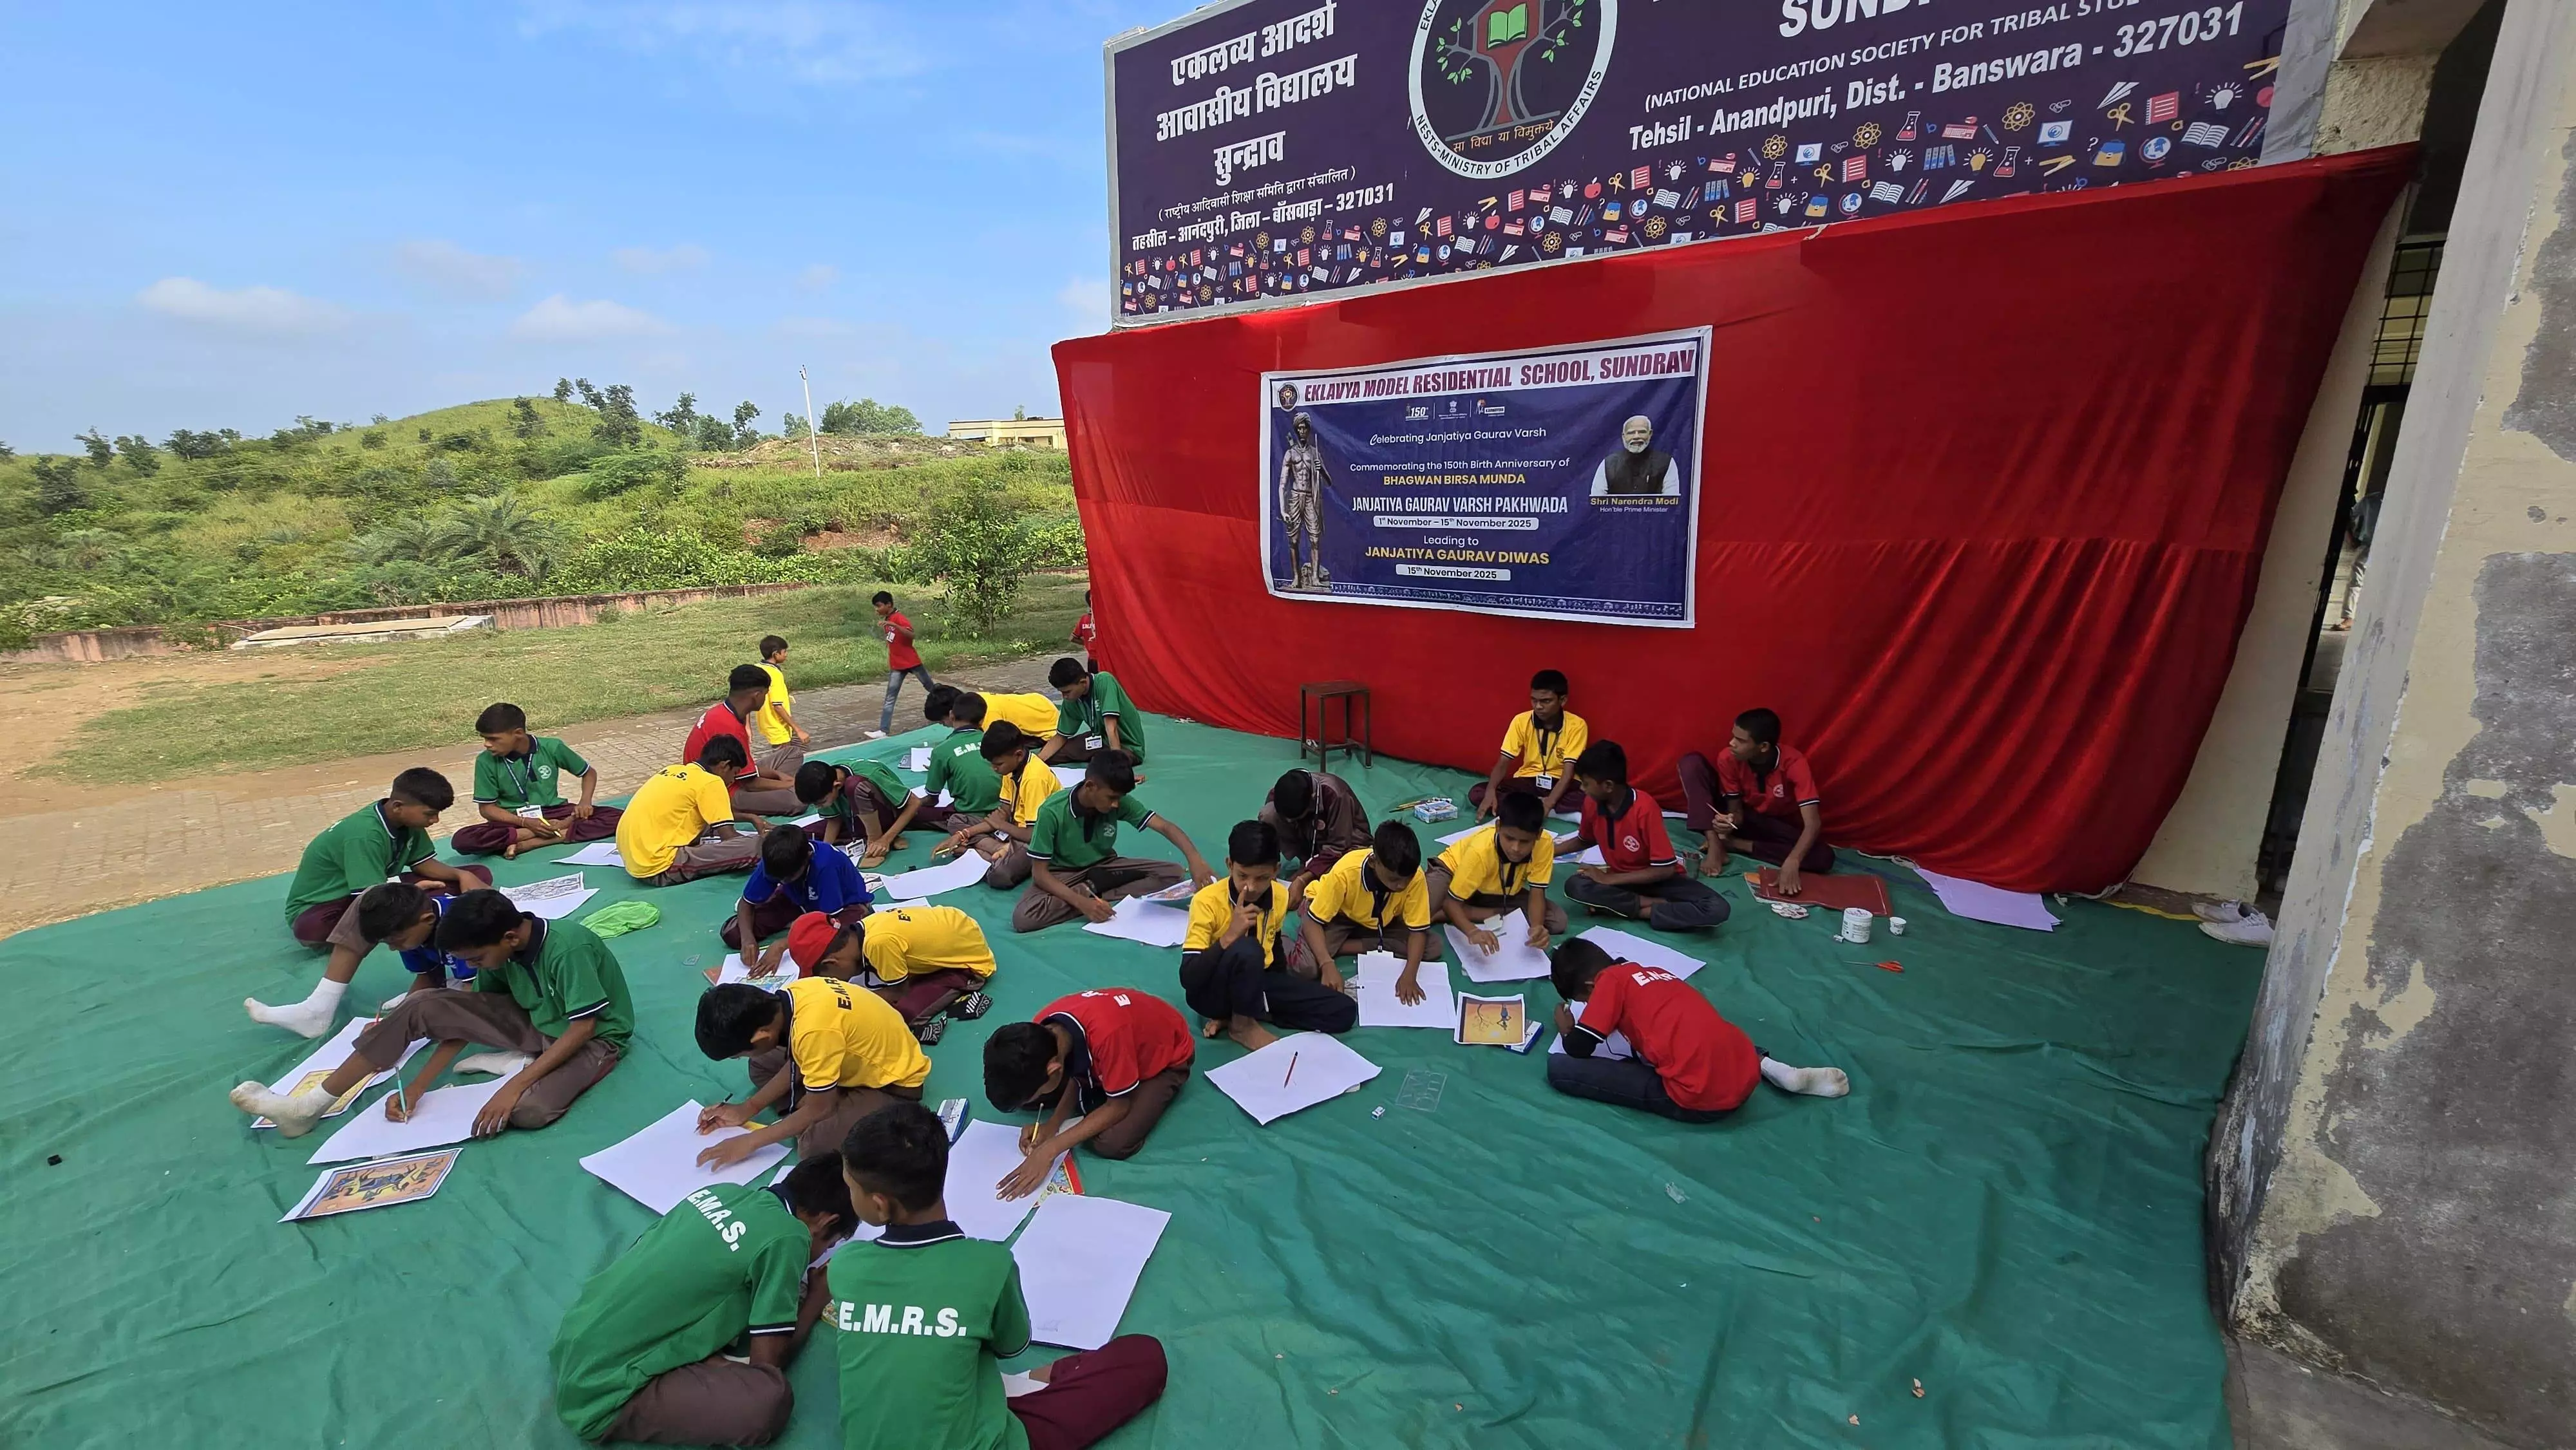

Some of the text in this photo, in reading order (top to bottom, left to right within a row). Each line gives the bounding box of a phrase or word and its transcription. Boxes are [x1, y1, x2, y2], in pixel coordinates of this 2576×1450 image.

[1171, 31, 1256, 86] एकलव्य
[1629, 115, 1691, 150] Tehsil
[1710, 87, 1837, 135] Anandpuri,
[1846, 73, 1905, 109] Dist.
[1932, 42, 2082, 93] Banswara
[2113, 1, 2243, 58] 327031
[1645, 78, 1734, 112] (NATIONAL
[1739, 53, 1844, 89] EDUCATION
[1850, 32, 1935, 66] SOCIETY
[1940, 23, 1984, 46] FOR
[1991, 5, 2071, 35] TRIBAL
[1157, 53, 1358, 141] आवासीय विद्यालय
[1417, 70, 1602, 174] NESTS-MINISTRY OF TRIBAL AFFAIRS
[1454, 142, 1464, 153] सा
[1498, 131, 1510, 142] या
[1213, 131, 1286, 185] सुन्द्राव
[1191, 194, 1230, 214] आदिवासी
[1231, 189, 1255, 205] शिक्षा
[1256, 182, 1283, 200] समिति
[1285, 178, 1305, 194] द्वारा
[1307, 168, 1349, 188] संचालित
[1132, 229, 1168, 251] तहसील
[1177, 214, 1229, 243] आनंदपुरी,
[1231, 210, 1262, 231] जिला
[1272, 198, 1323, 223] बाँसवाड़ा
[1336, 182, 1394, 212] 327031
[1305, 350, 1694, 402] EKLAVYA MODEL RESIDENTIAL SCHOOL, SUNDRAV
[1370, 428, 1546, 446] Celebrating Janjatiya Gaurav Varsh
[1350, 460, 1425, 472] Commemorating
[1444, 460, 1468, 469] 150th
[1470, 460, 1493, 469] Birth
[1495, 458, 1557, 470] Anniversary
[1558, 457, 1570, 467] of
[1384, 473, 1526, 485] BHAGWAN BIRSA MUNDA
[1352, 496, 1568, 513] JANJATIYA GAURAV VARSH PAKHWADA
[1387, 518, 1432, 527] November
[1456, 519, 1506, 528] November
[1508, 520, 1531, 529] 2025
[1365, 546, 1550, 565] JANJATIYA GAURAV DIWAS
[1423, 535, 1479, 548] Leading to
[1408, 567, 1497, 579] 15th November 2025
[687, 1189, 746, 1252] E.M.R.S.
[839, 1301, 967, 1337] E.M.R.S.
